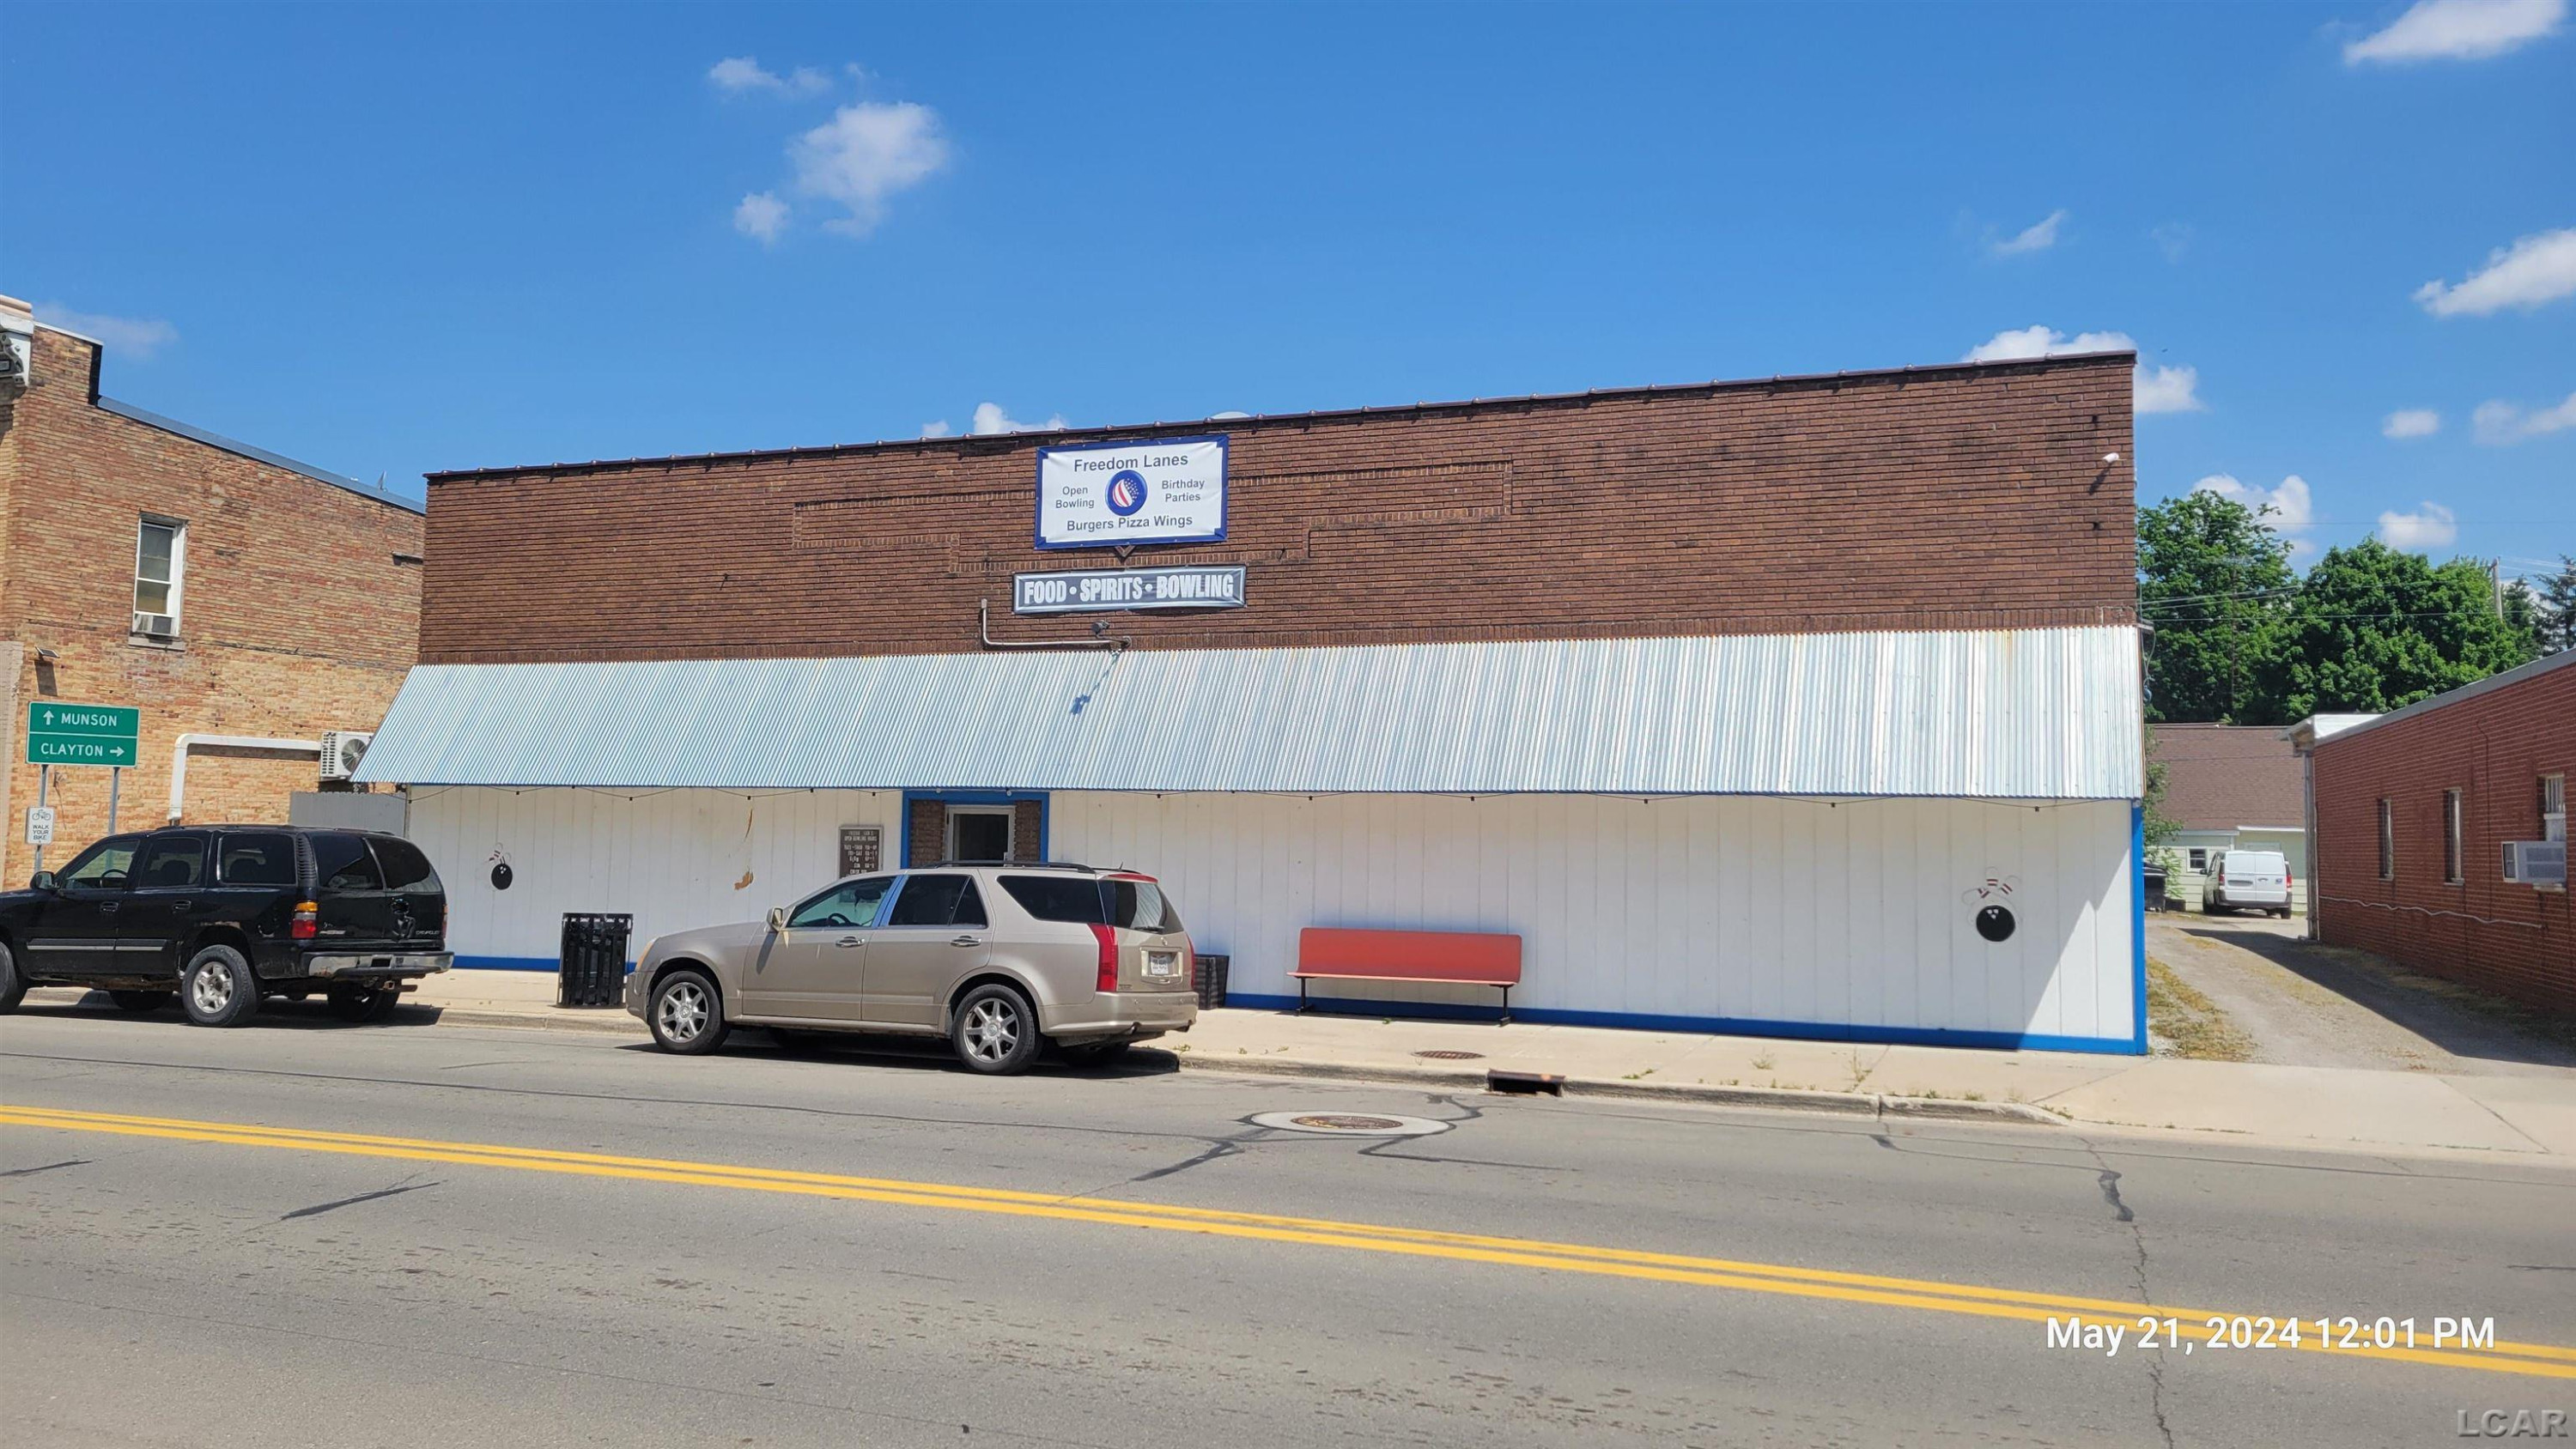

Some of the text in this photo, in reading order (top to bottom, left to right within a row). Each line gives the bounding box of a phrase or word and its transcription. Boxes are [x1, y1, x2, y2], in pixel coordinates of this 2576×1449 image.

[1073, 454, 1188, 472] Freedom Lanes
[1161, 479, 1206, 490] Birthday
[1061, 486, 1089, 497] Open
[1164, 492, 1200, 502] Parties
[1055, 498, 1095, 509] Bowling
[1066, 515, 1194, 532] Burgers Pizza Wings
[1024, 574, 1234, 604] FOOD SPIRITS BOWLING
[61, 712, 118, 727] MUNSON
[40, 743, 103, 756] CLAYTON
